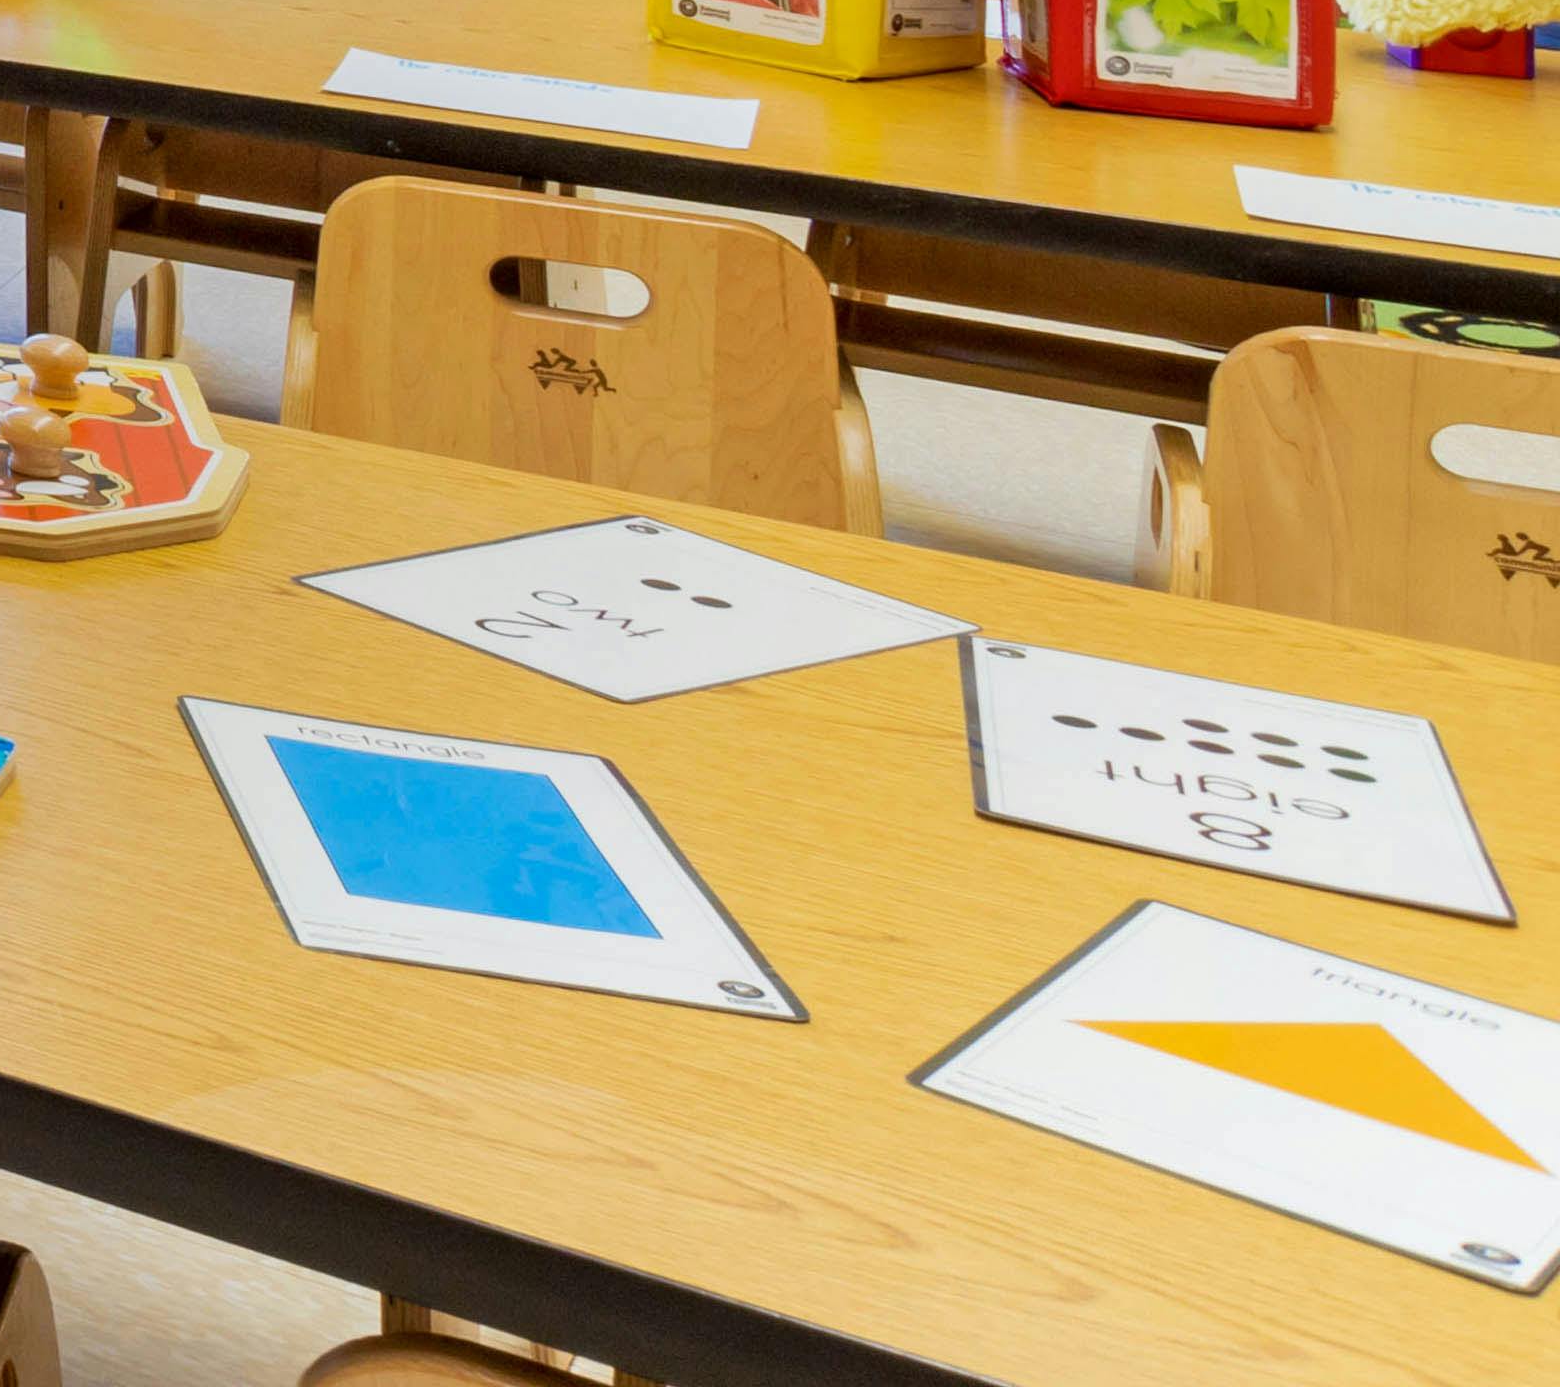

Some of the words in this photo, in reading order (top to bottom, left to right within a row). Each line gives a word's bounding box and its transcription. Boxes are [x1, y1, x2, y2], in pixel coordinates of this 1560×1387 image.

[475, 610, 573, 639] 2
[531, 590, 665, 638] two
[297, 724, 486, 761] rectangle
[1095, 760, 1350, 821] eight
[1189, 811, 1272, 852] 8
[1309, 966, 1503, 1032] triangle
